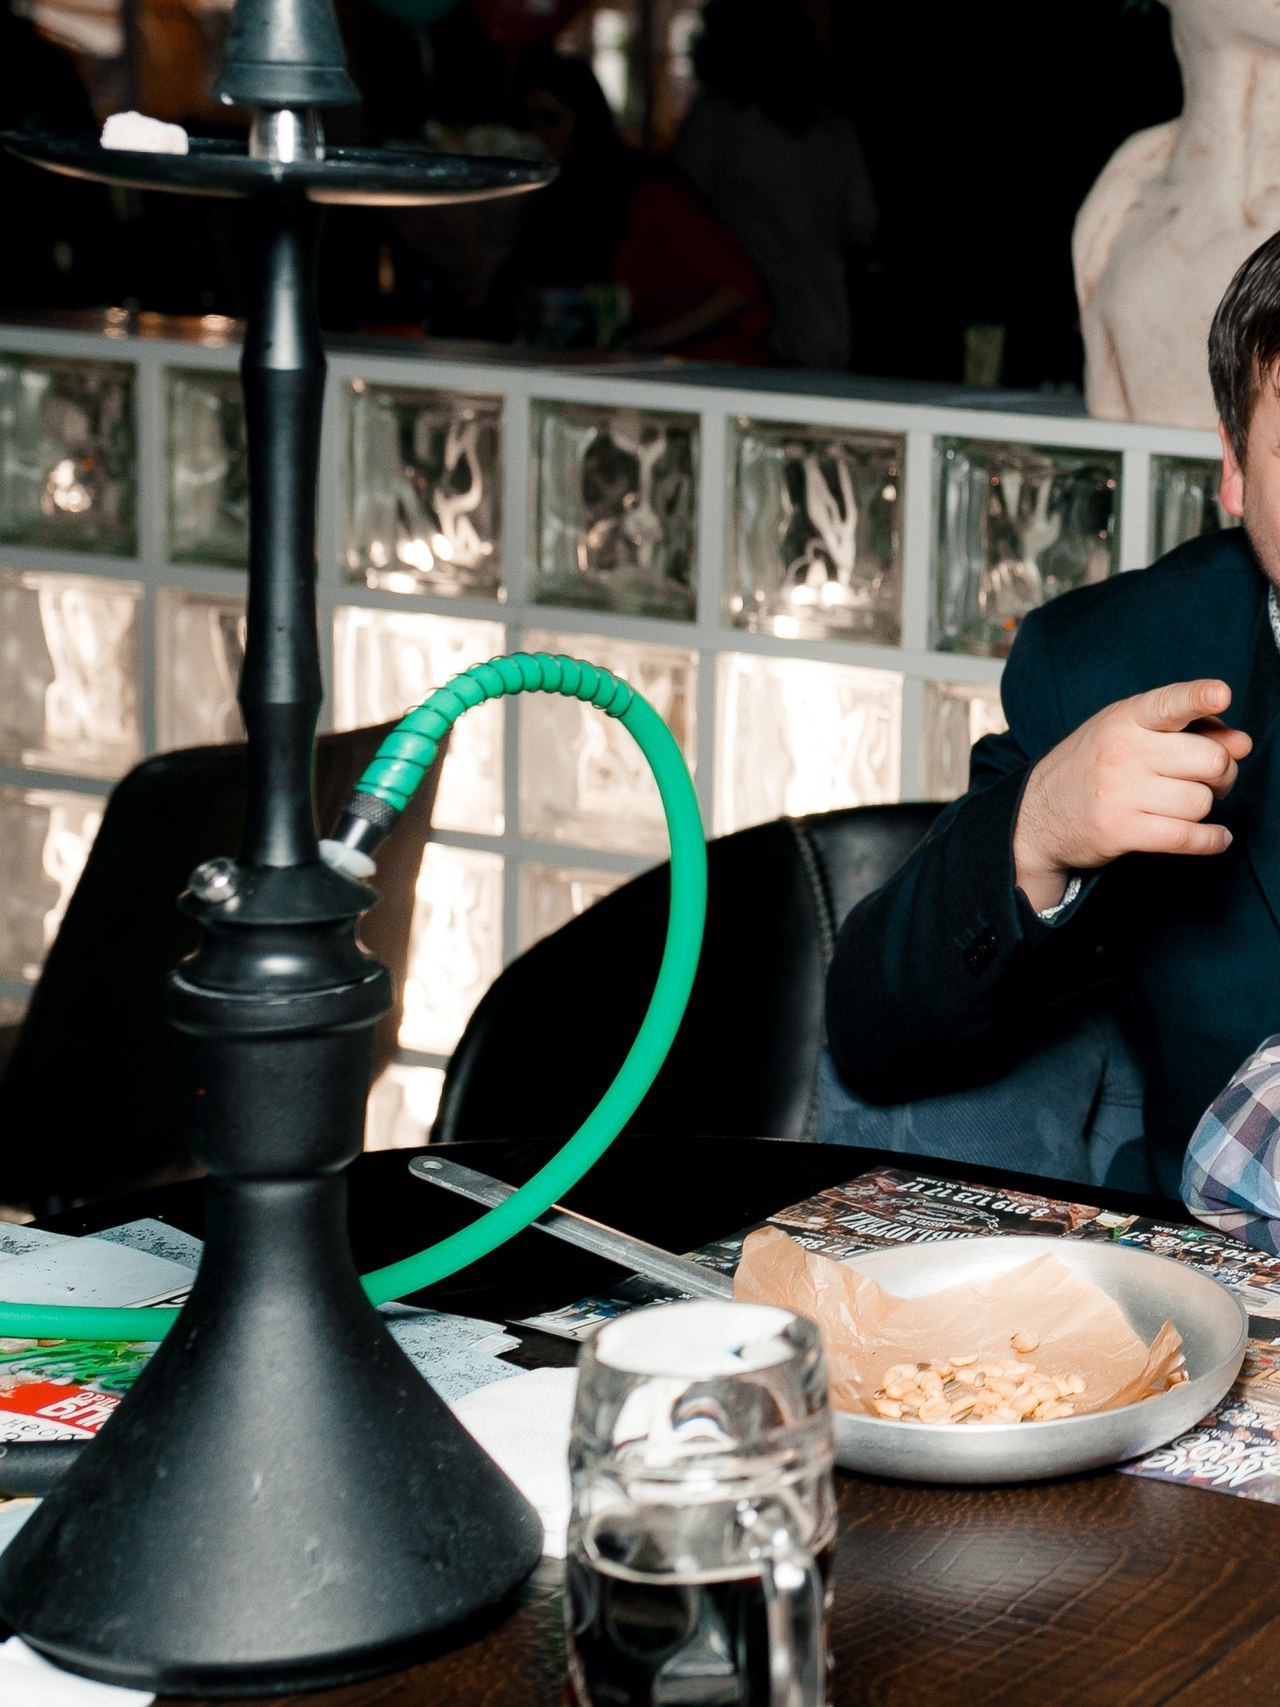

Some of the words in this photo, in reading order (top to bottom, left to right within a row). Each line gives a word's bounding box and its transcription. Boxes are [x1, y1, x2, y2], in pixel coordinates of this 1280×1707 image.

[896, 1181, 925, 1193] 17
[923, 1187, 953, 1198] 17
[953, 1192, 992, 1207] 173
[991, 1200, 1034, 1215] 919
[1030, 1208, 1051, 1218] 8
[1151, 1225, 1187, 1236] этаж
[1118, 1231, 1152, 1243] 57
[1180, 1241, 1221, 1254] 271
[1222, 1249, 1262, 1264] 910
